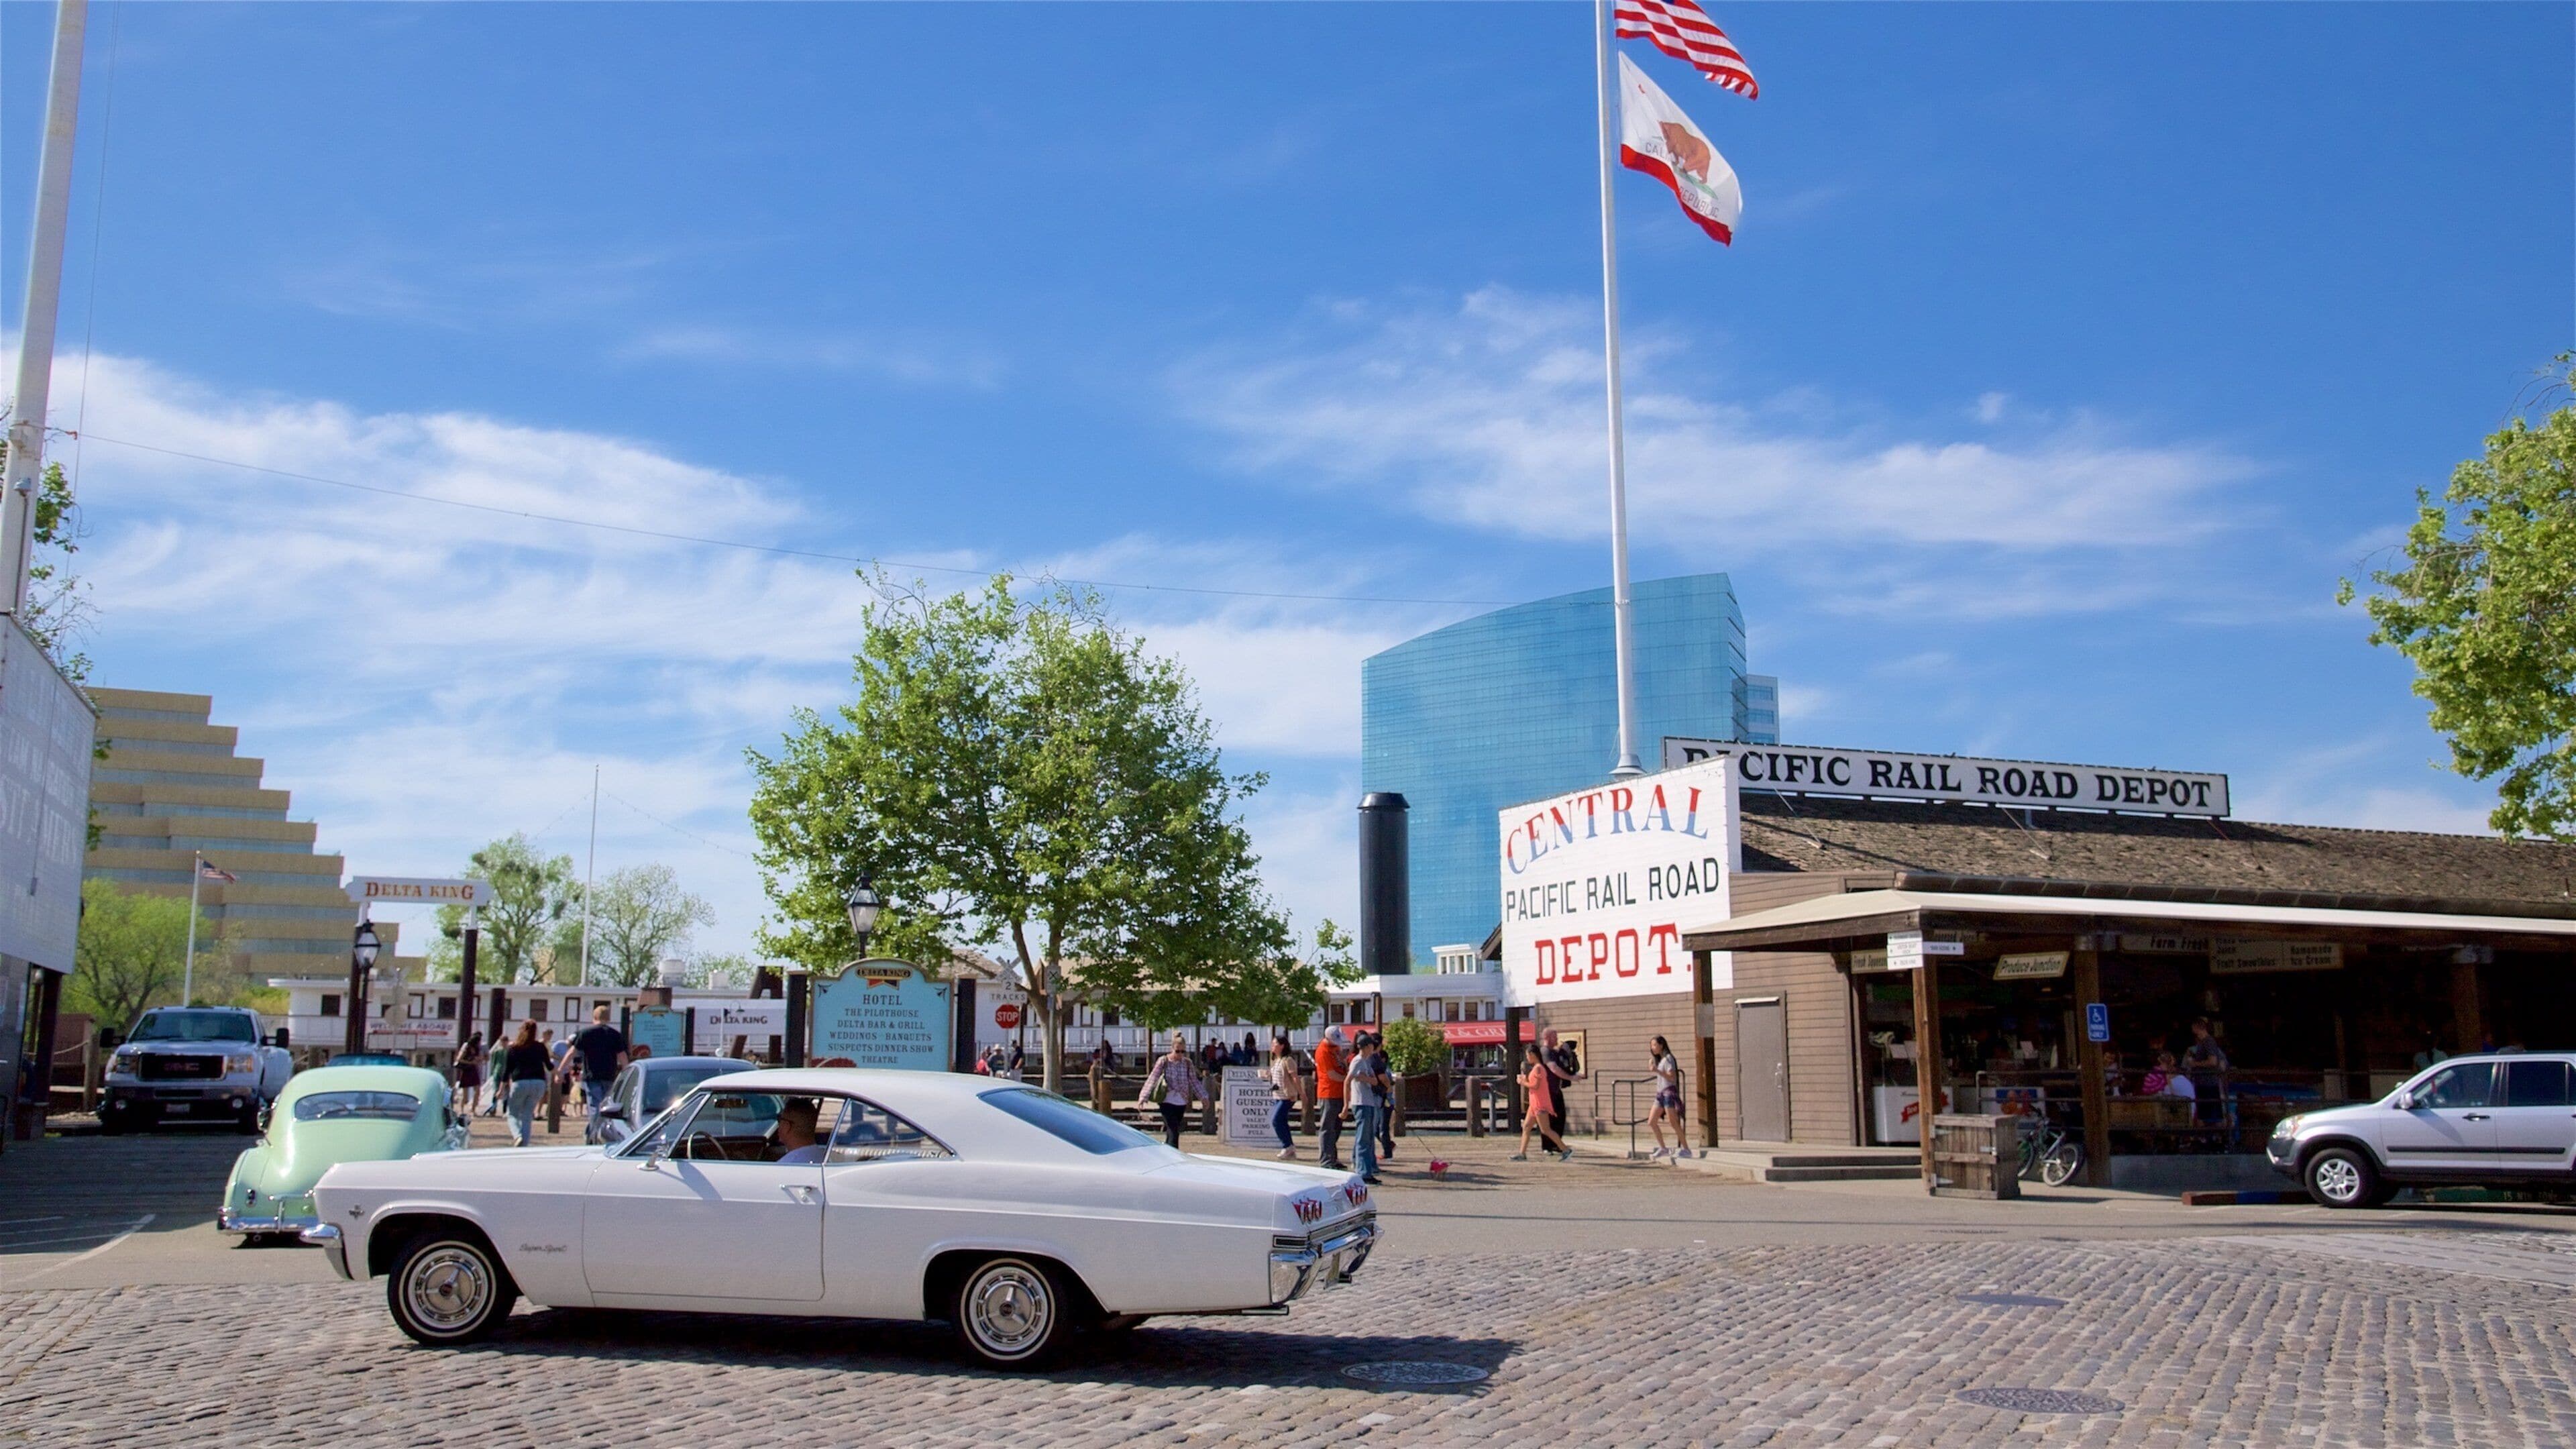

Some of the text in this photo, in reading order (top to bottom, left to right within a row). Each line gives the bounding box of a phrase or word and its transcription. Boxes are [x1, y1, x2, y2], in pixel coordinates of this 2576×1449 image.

[1868, 759, 1962, 792] RAIL
[1977, 766, 2078, 798] ROAD
[2095, 773, 2211, 807] DEPOT
[1507, 784, 1709, 874] CENTRAL
[366, 882, 474, 900] DELTA KING
[1506, 857, 1719, 922] PACIFIC RAIL ROAD
[2151, 936, 2175, 948] Farm
[2001, 957, 2061, 973] Produce Junction
[1005, 981, 1012, 990] 2
[863, 994, 903, 1006] HOTEL
[845, 1008, 919, 1018] THE PILOTHOUSE
[997, 1012, 1019, 1022] STOP
[742, 1016, 768, 1025] KING
[837, 1020, 865, 1028] DELTA
[868, 1020, 886, 1029] BAR
[898, 1021, 925, 1030] GRILL
[829, 1031, 932, 1041] WEDDINGS BANQUETS
[828, 1044, 934, 1053] SUSPECTS DINNER SHOW
[861, 1055, 898, 1063] THEATRE
[1242, 1108, 1270, 1116] ONLY
[2503, 1191, 2512, 1200] 15
